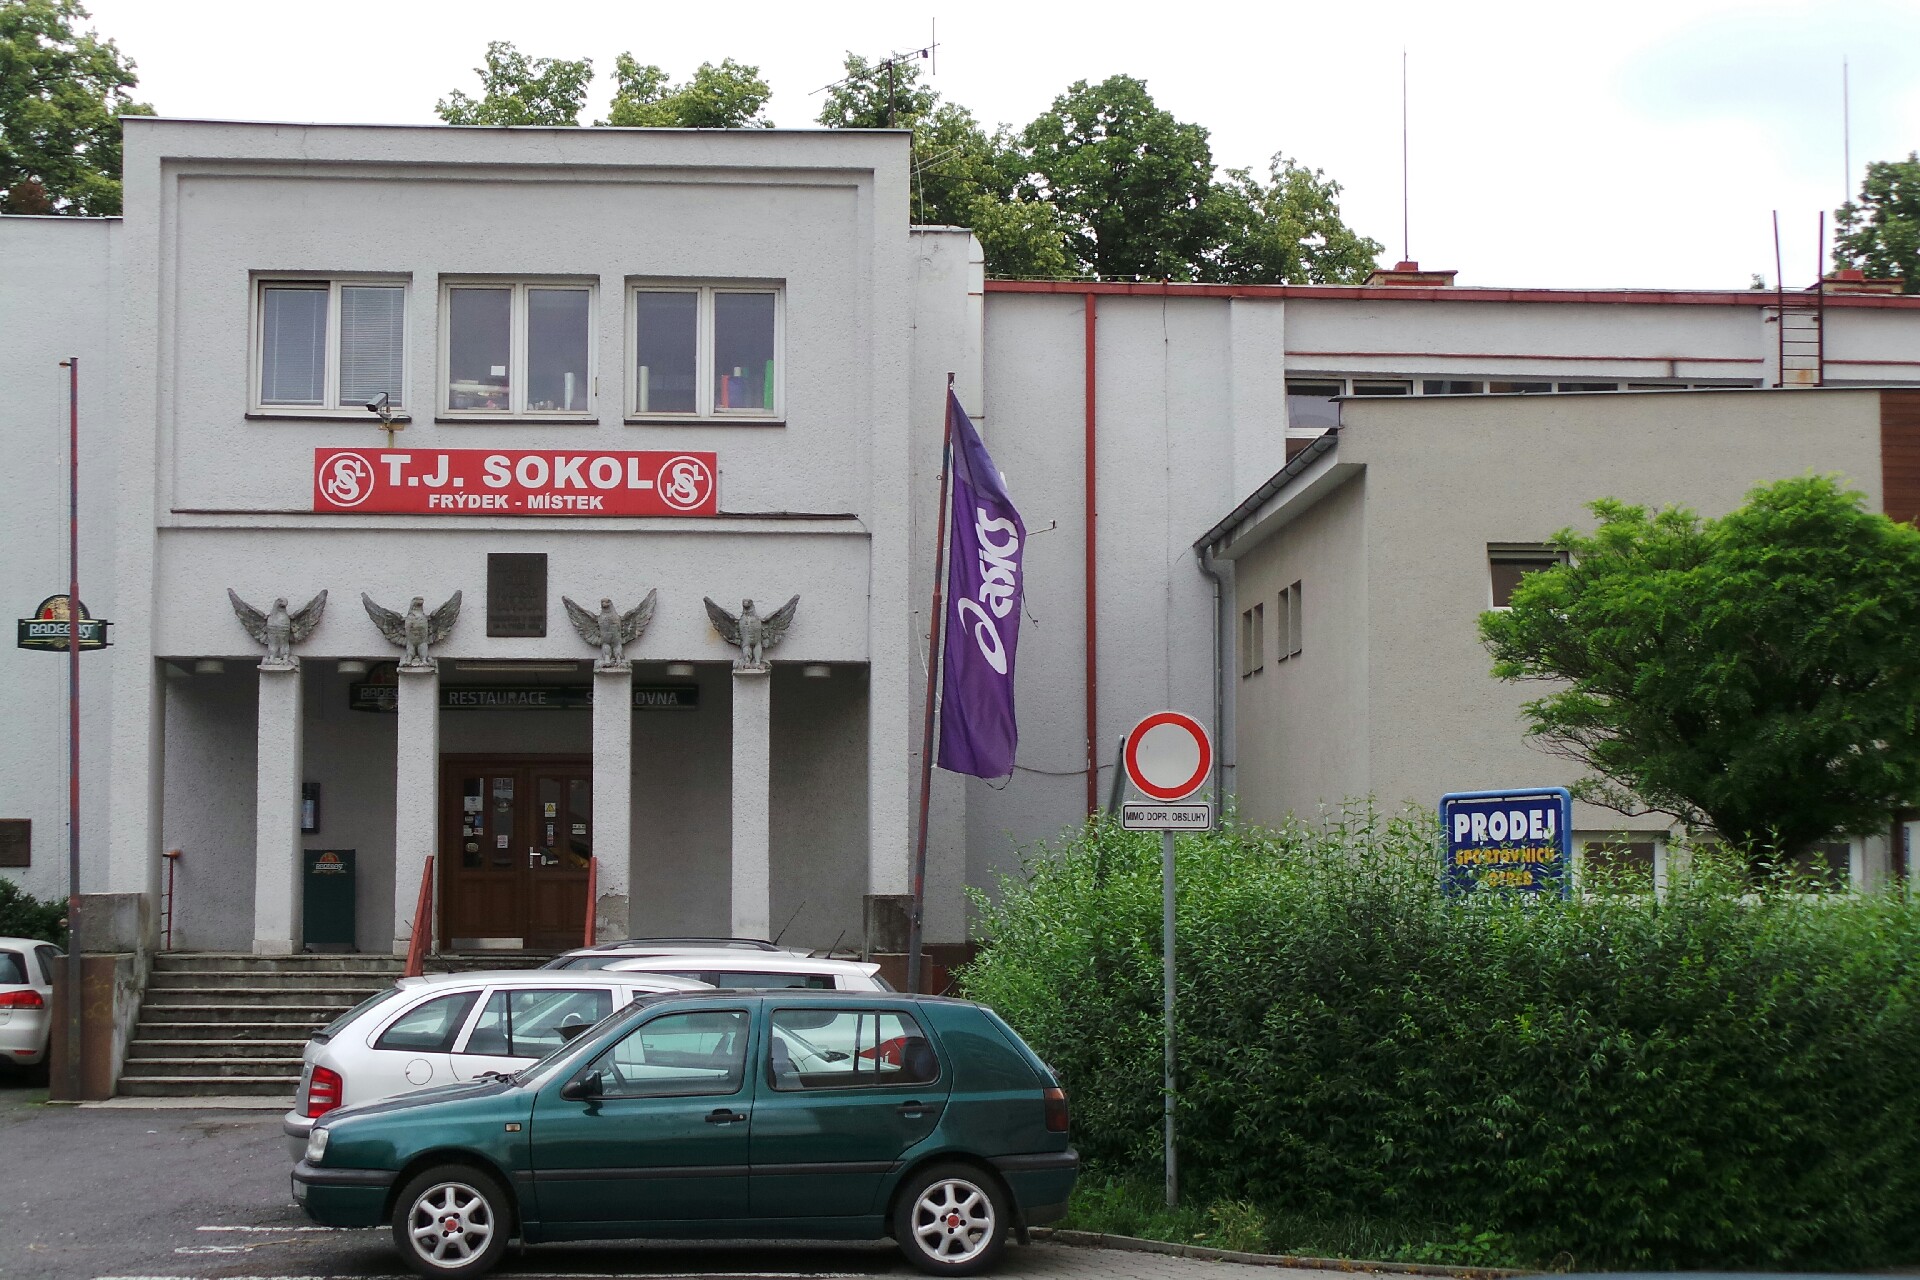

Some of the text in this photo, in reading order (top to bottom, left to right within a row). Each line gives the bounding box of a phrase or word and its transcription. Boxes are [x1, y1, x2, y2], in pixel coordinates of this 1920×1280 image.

[380, 454, 654, 489] T.J. SOKOL
[429, 492, 509, 509] FRÝDEK
[528, 492, 603, 510] MÍSTEK
[30, 624, 93, 638] RADEGST
[449, 692, 547, 705] RESTAURACE
[1126, 812, 1144, 820] MIMO
[1172, 812, 1206, 821] OBSLUHY
[1454, 809, 1556, 843] PRODEJ
